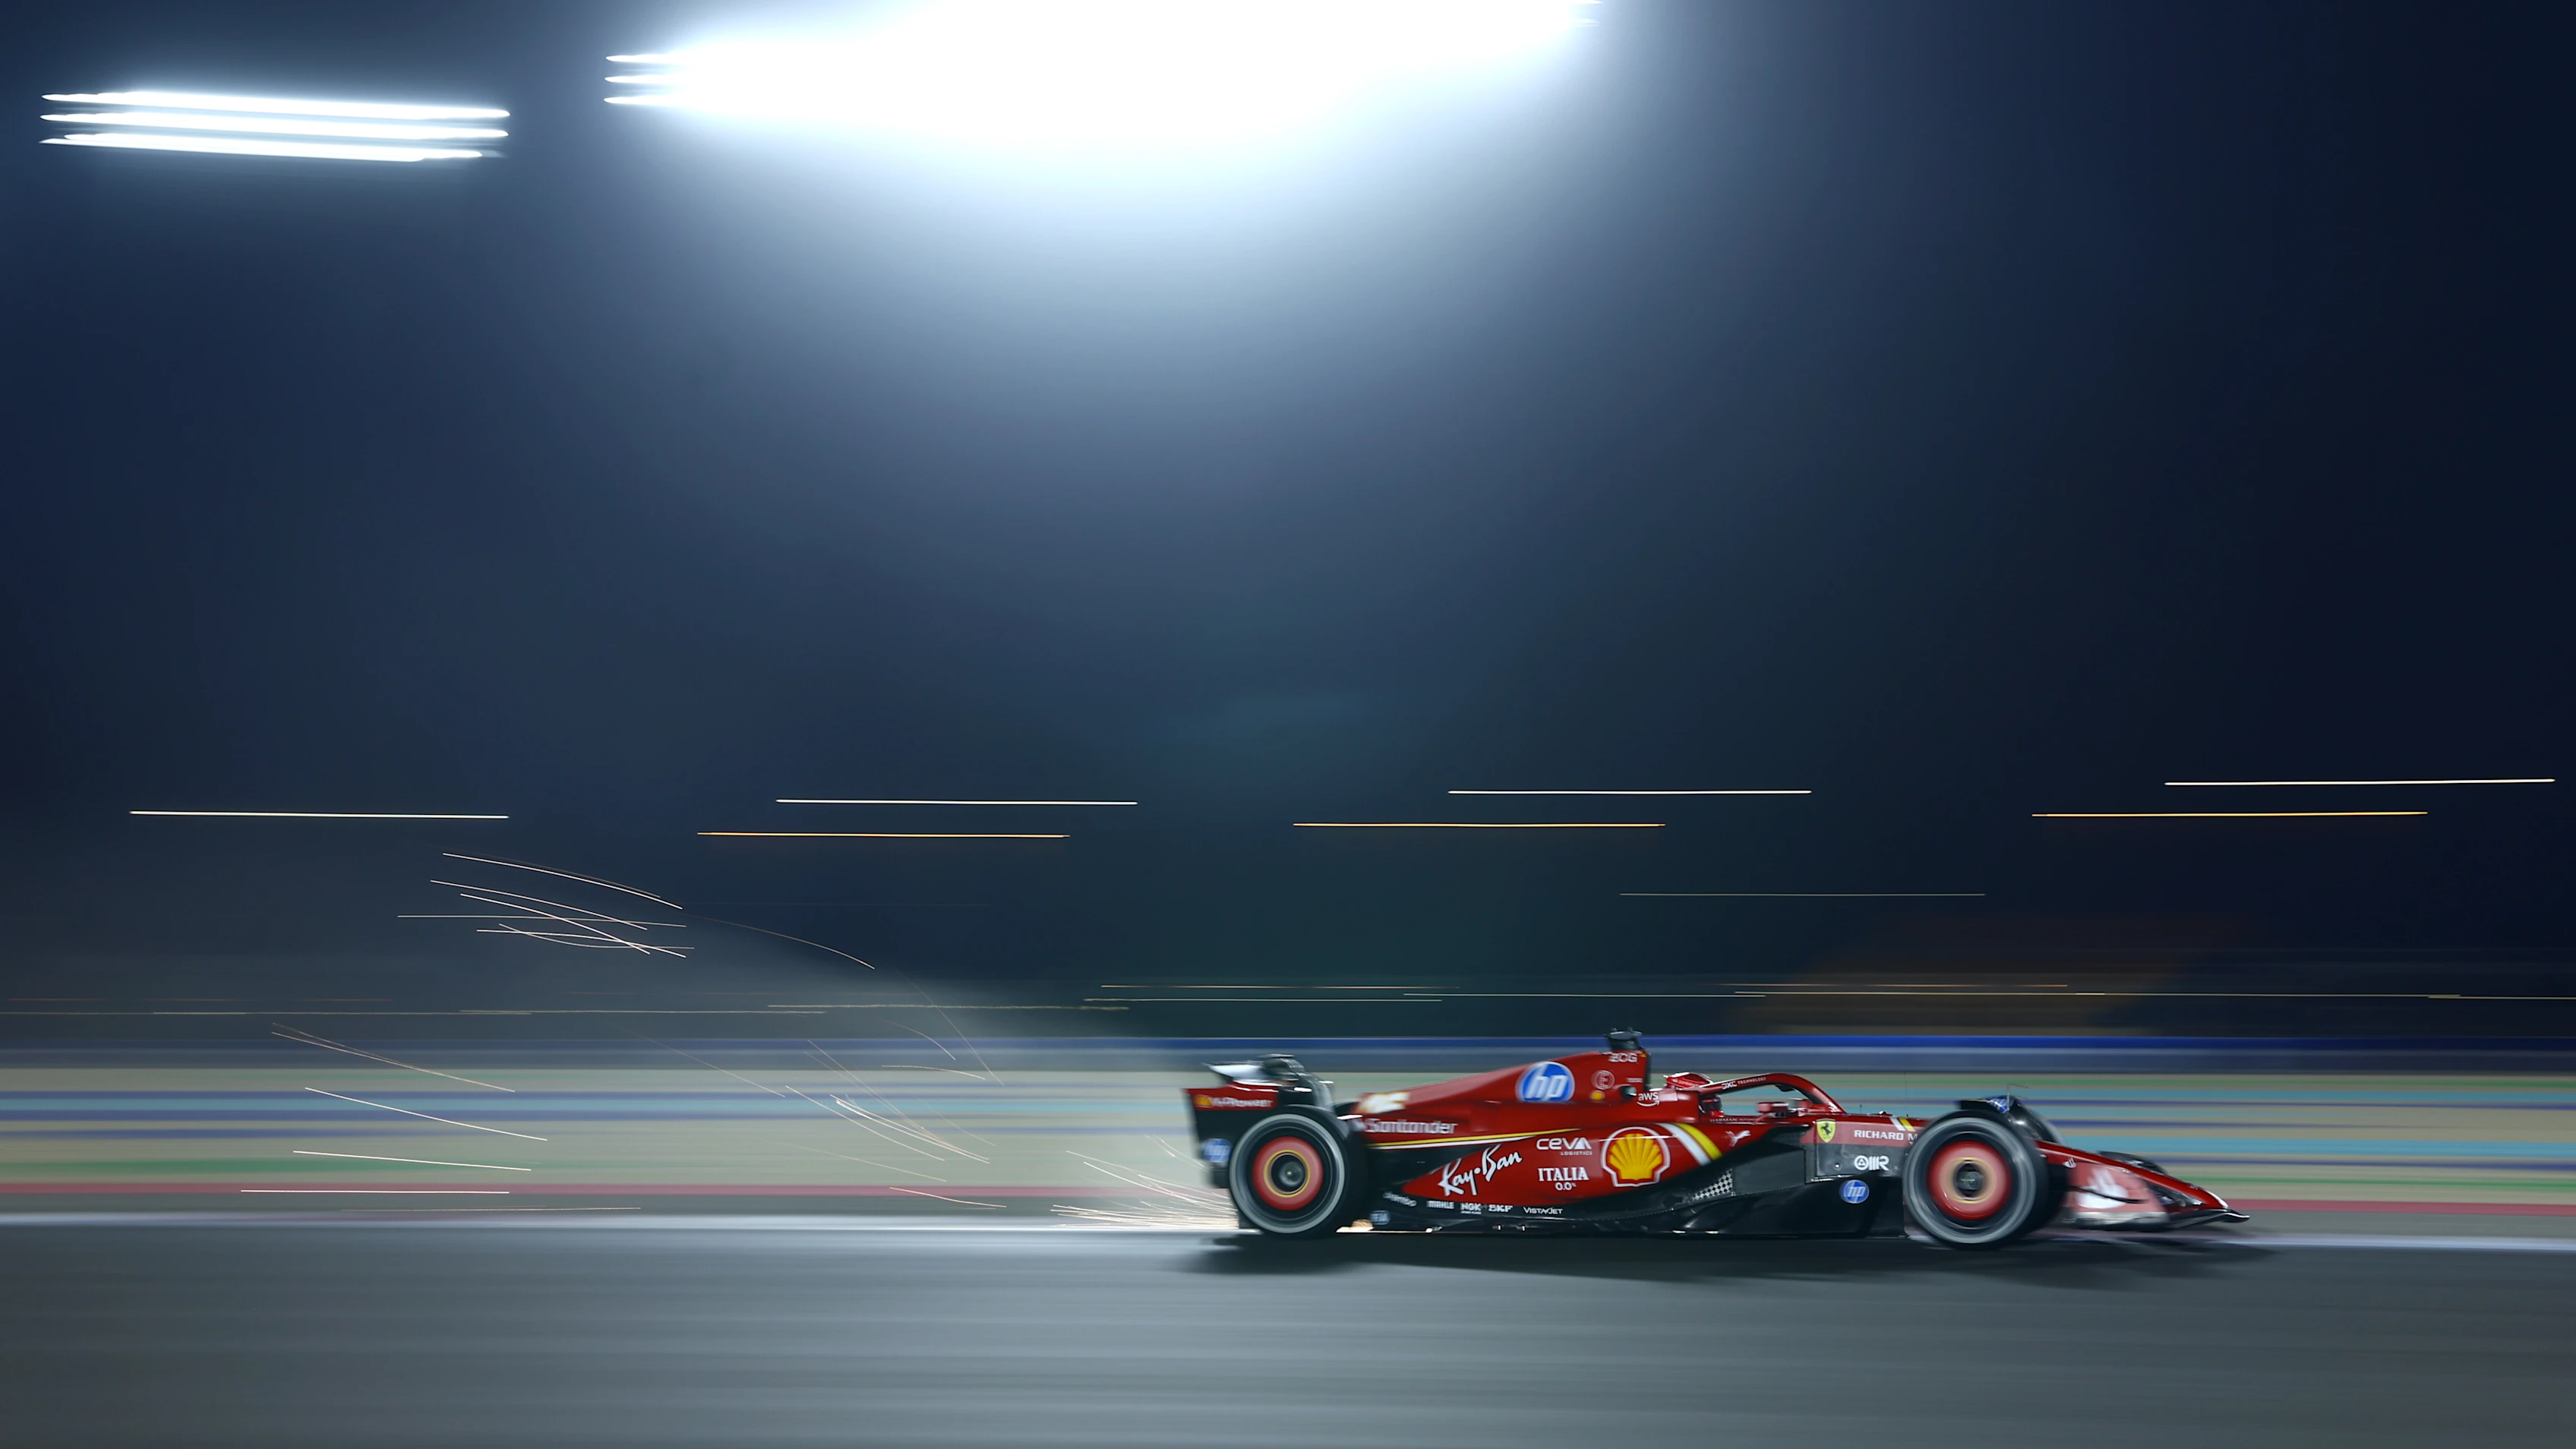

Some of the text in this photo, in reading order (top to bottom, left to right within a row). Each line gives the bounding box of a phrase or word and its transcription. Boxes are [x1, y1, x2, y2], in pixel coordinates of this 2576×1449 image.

[1365, 1118, 1458, 1134] Santander
[1854, 1129, 1904, 1141] RICHARD
[1537, 1166, 1589, 1182] ITALIA
[1426, 1200, 1454, 1209] MAHLE
